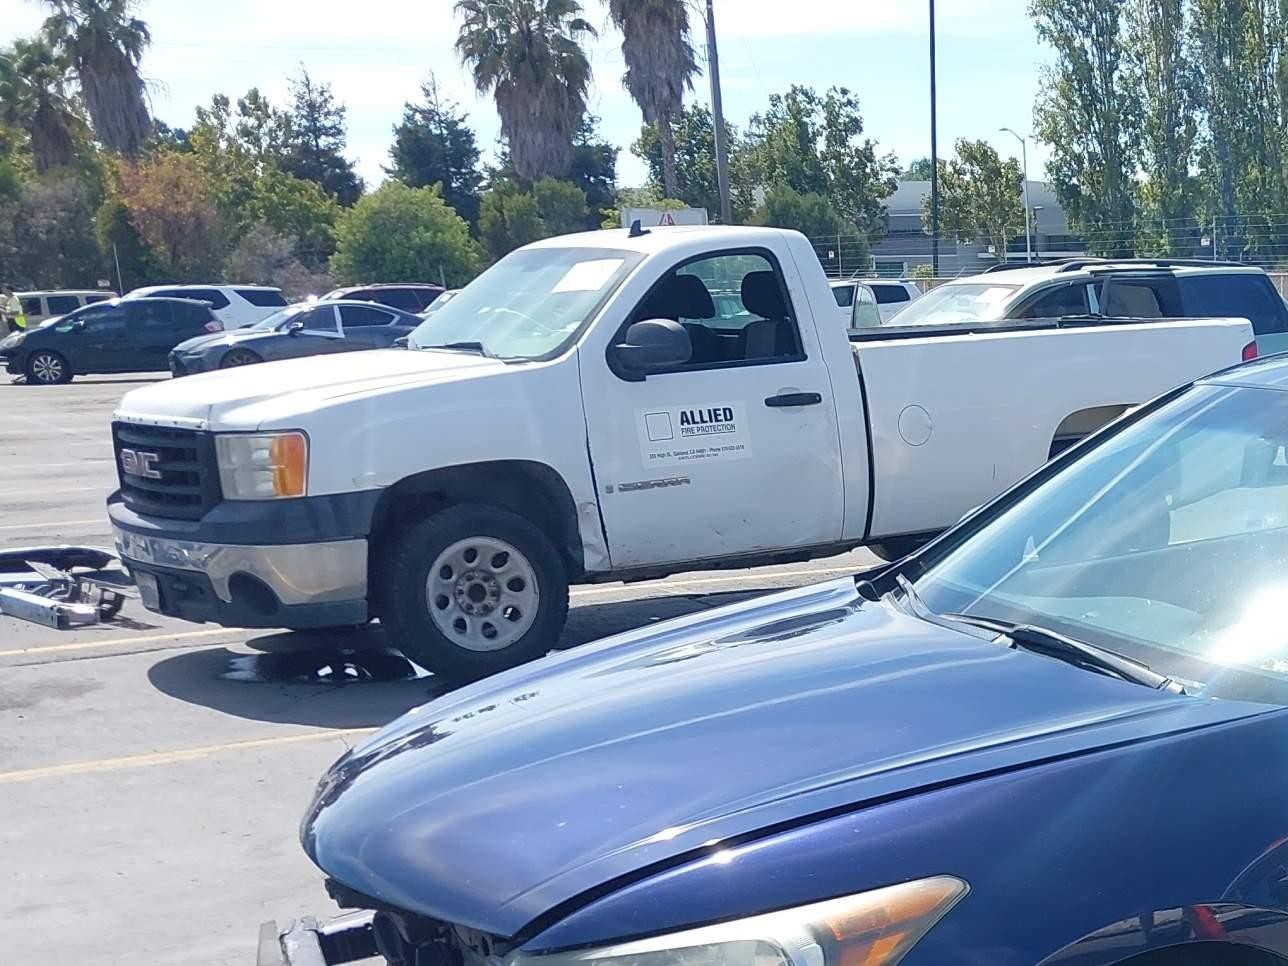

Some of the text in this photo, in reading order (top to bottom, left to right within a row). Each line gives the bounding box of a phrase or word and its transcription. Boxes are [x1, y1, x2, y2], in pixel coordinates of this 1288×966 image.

[680, 407, 734, 426] ALLIED
[681, 424, 736, 435] FIRE PROTECTION
